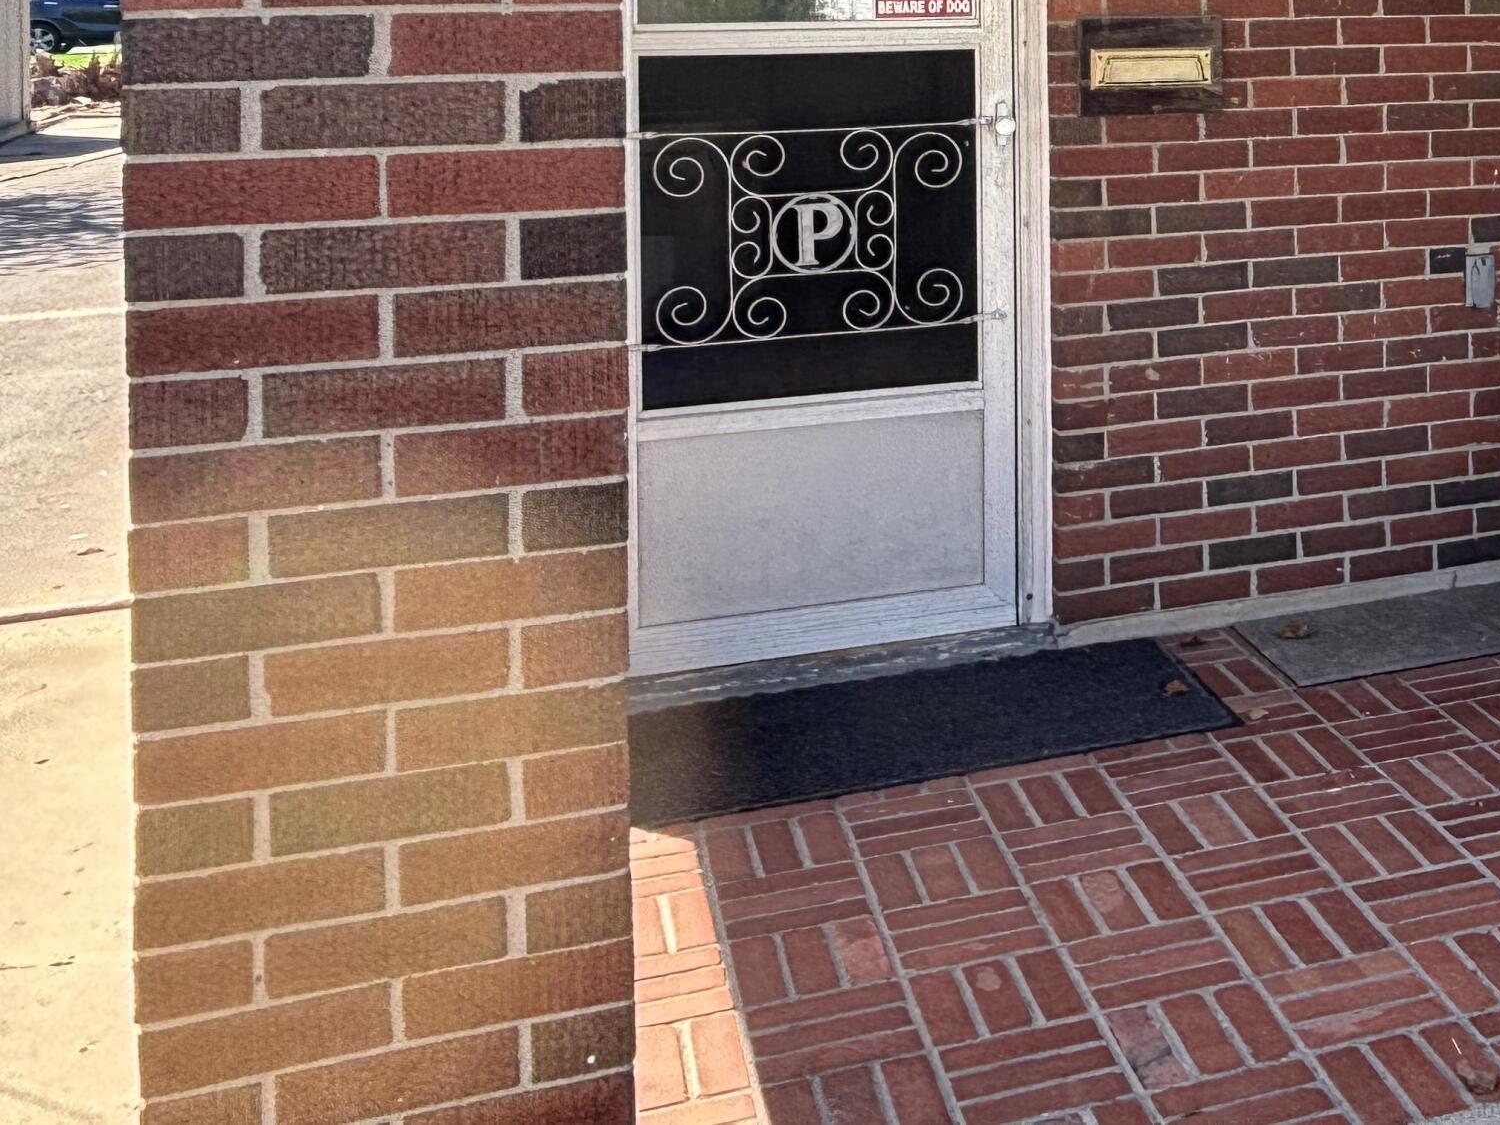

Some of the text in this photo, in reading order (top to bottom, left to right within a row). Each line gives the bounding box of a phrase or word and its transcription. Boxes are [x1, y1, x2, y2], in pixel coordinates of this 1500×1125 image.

[877, 0, 971, 15] BEWARE OF DOG
[792, 203, 843, 266] P
